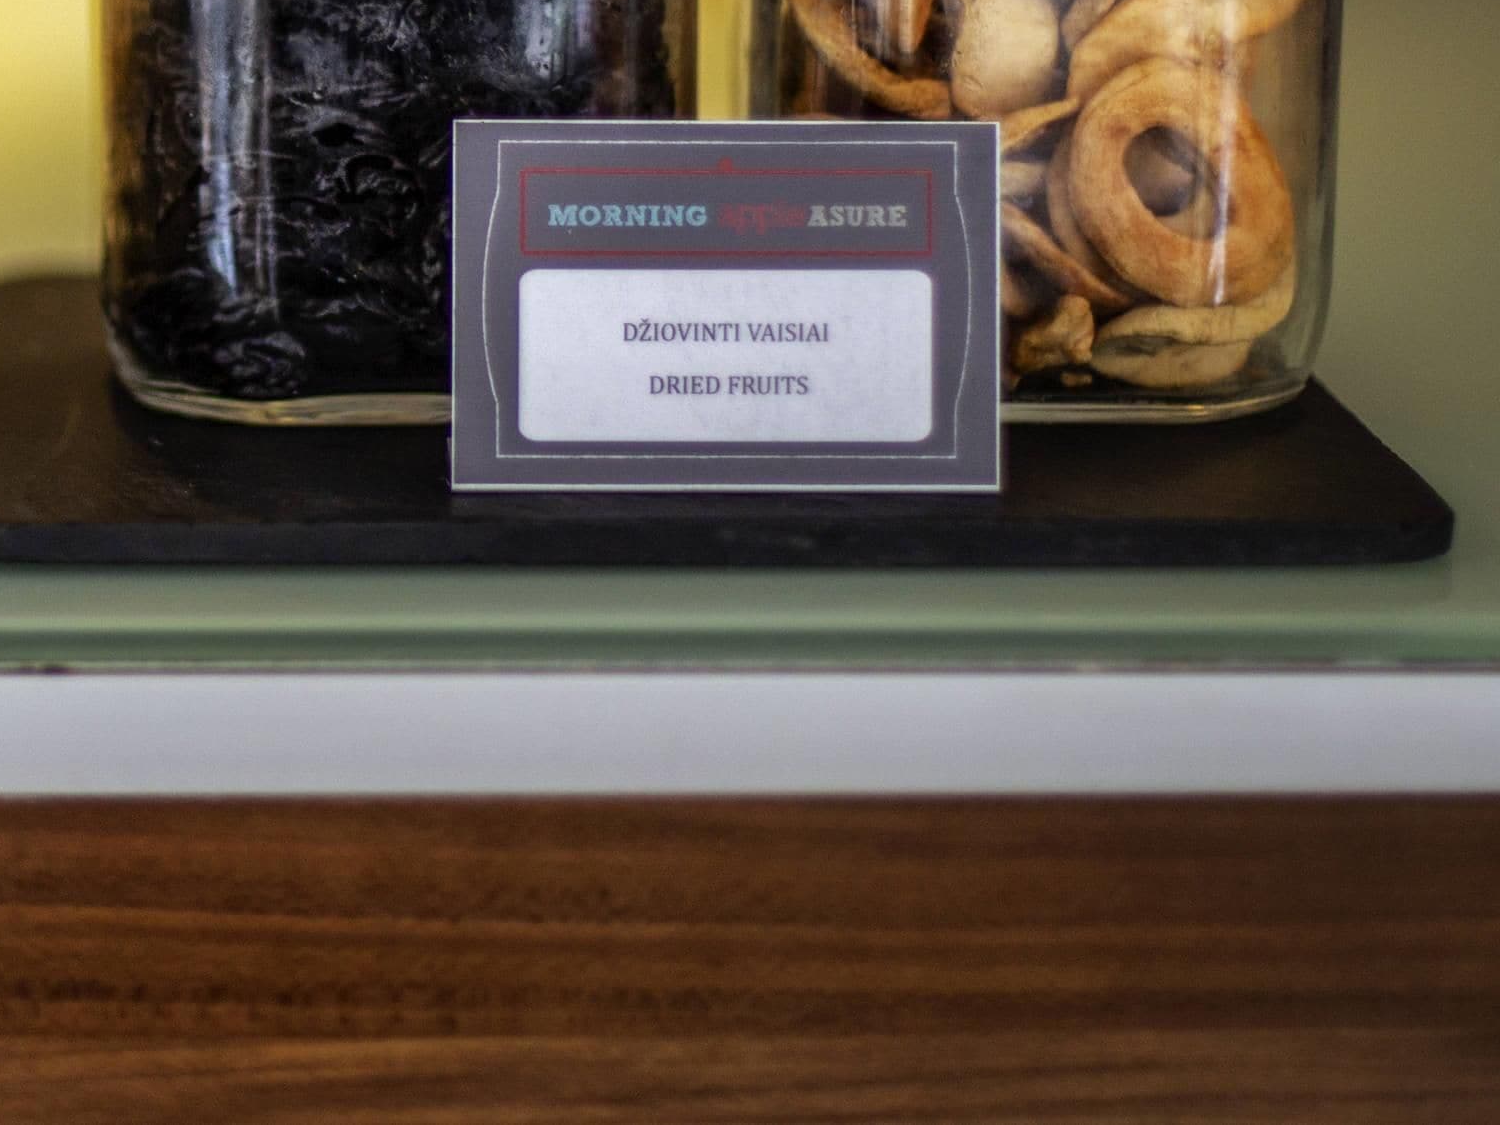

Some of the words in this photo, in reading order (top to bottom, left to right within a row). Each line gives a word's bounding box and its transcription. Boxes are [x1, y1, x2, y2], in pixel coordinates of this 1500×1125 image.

[547, 203, 708, 228] MORNING
[623, 318, 741, 343] DŽIOVINTI
[747, 322, 830, 343] VAISIAI
[649, 375, 721, 396] DRIED
[728, 375, 810, 396] FRUITS
